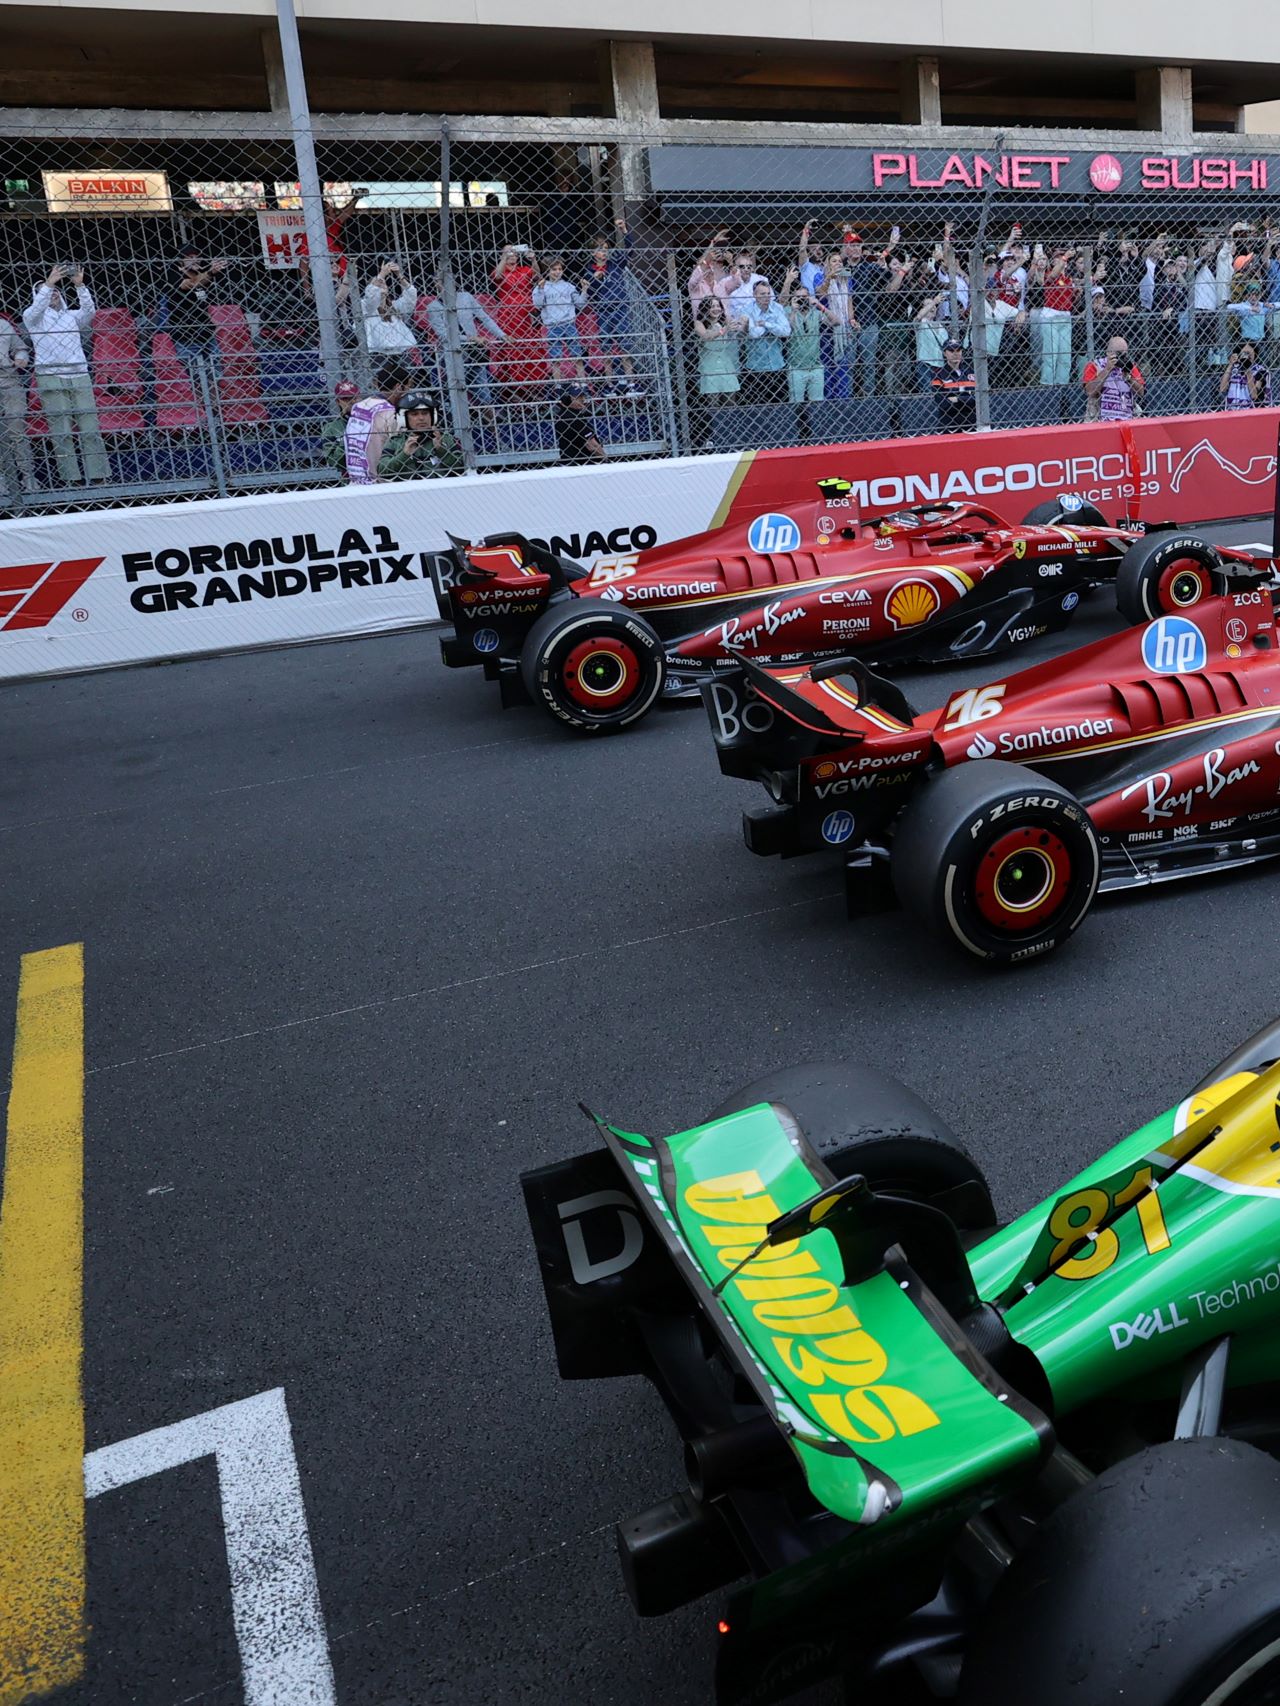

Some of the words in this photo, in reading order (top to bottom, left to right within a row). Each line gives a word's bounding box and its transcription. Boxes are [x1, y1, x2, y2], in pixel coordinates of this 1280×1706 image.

[873, 154, 1070, 188] PLANET
[1142, 158, 1267, 190] SUSHI
[70, 180, 146, 194] BALKIN
[264, 215, 305, 227] TRIBUNE
[848, 463, 1036, 508] MONACO
[1037, 447, 1182, 487] CIRCUIT
[1056, 488, 1112, 502] NCE
[1117, 482, 1161, 499] 1929
[826, 498, 850, 508] ZCG
[758, 516, 792, 553] hp
[121, 528, 373, 583] FORMULA
[1038, 542, 1073, 552] RICHARD
[1074, 540, 1098, 549] MILLE
[1164, 539, 1204, 558] ZERO
[590, 554, 641, 588] 55
[478, 586, 543, 601] V-Power
[625, 580, 718, 601] Santander
[1232, 592, 1262, 607] ZCG
[463, 602, 512, 619] VGW
[823, 617, 870, 630] PERONI
[475, 632, 497, 652] hp
[625, 621, 655, 648] PIRELLI
[1154, 620, 1203, 674] hp
[666, 655, 703, 666] brembo
[716, 658, 739, 666] MAHL
[780, 653, 804, 662] SKF
[943, 684, 1008, 733] 16
[1000, 718, 1114, 755] Santander
[838, 749, 922, 774] V-Power
[815, 773, 877, 800] VGW
[969, 819, 984, 839] P
[990, 796, 1061, 822] ZERO
[1210, 816, 1238, 830] SKF
[827, 813, 850, 843] hp
[1128, 829, 1164, 842] MAHLE
[1173, 824, 1198, 837] NGK
[1048, 1165, 1171, 1281] 81
[1108, 1305, 1189, 1351] DELL
